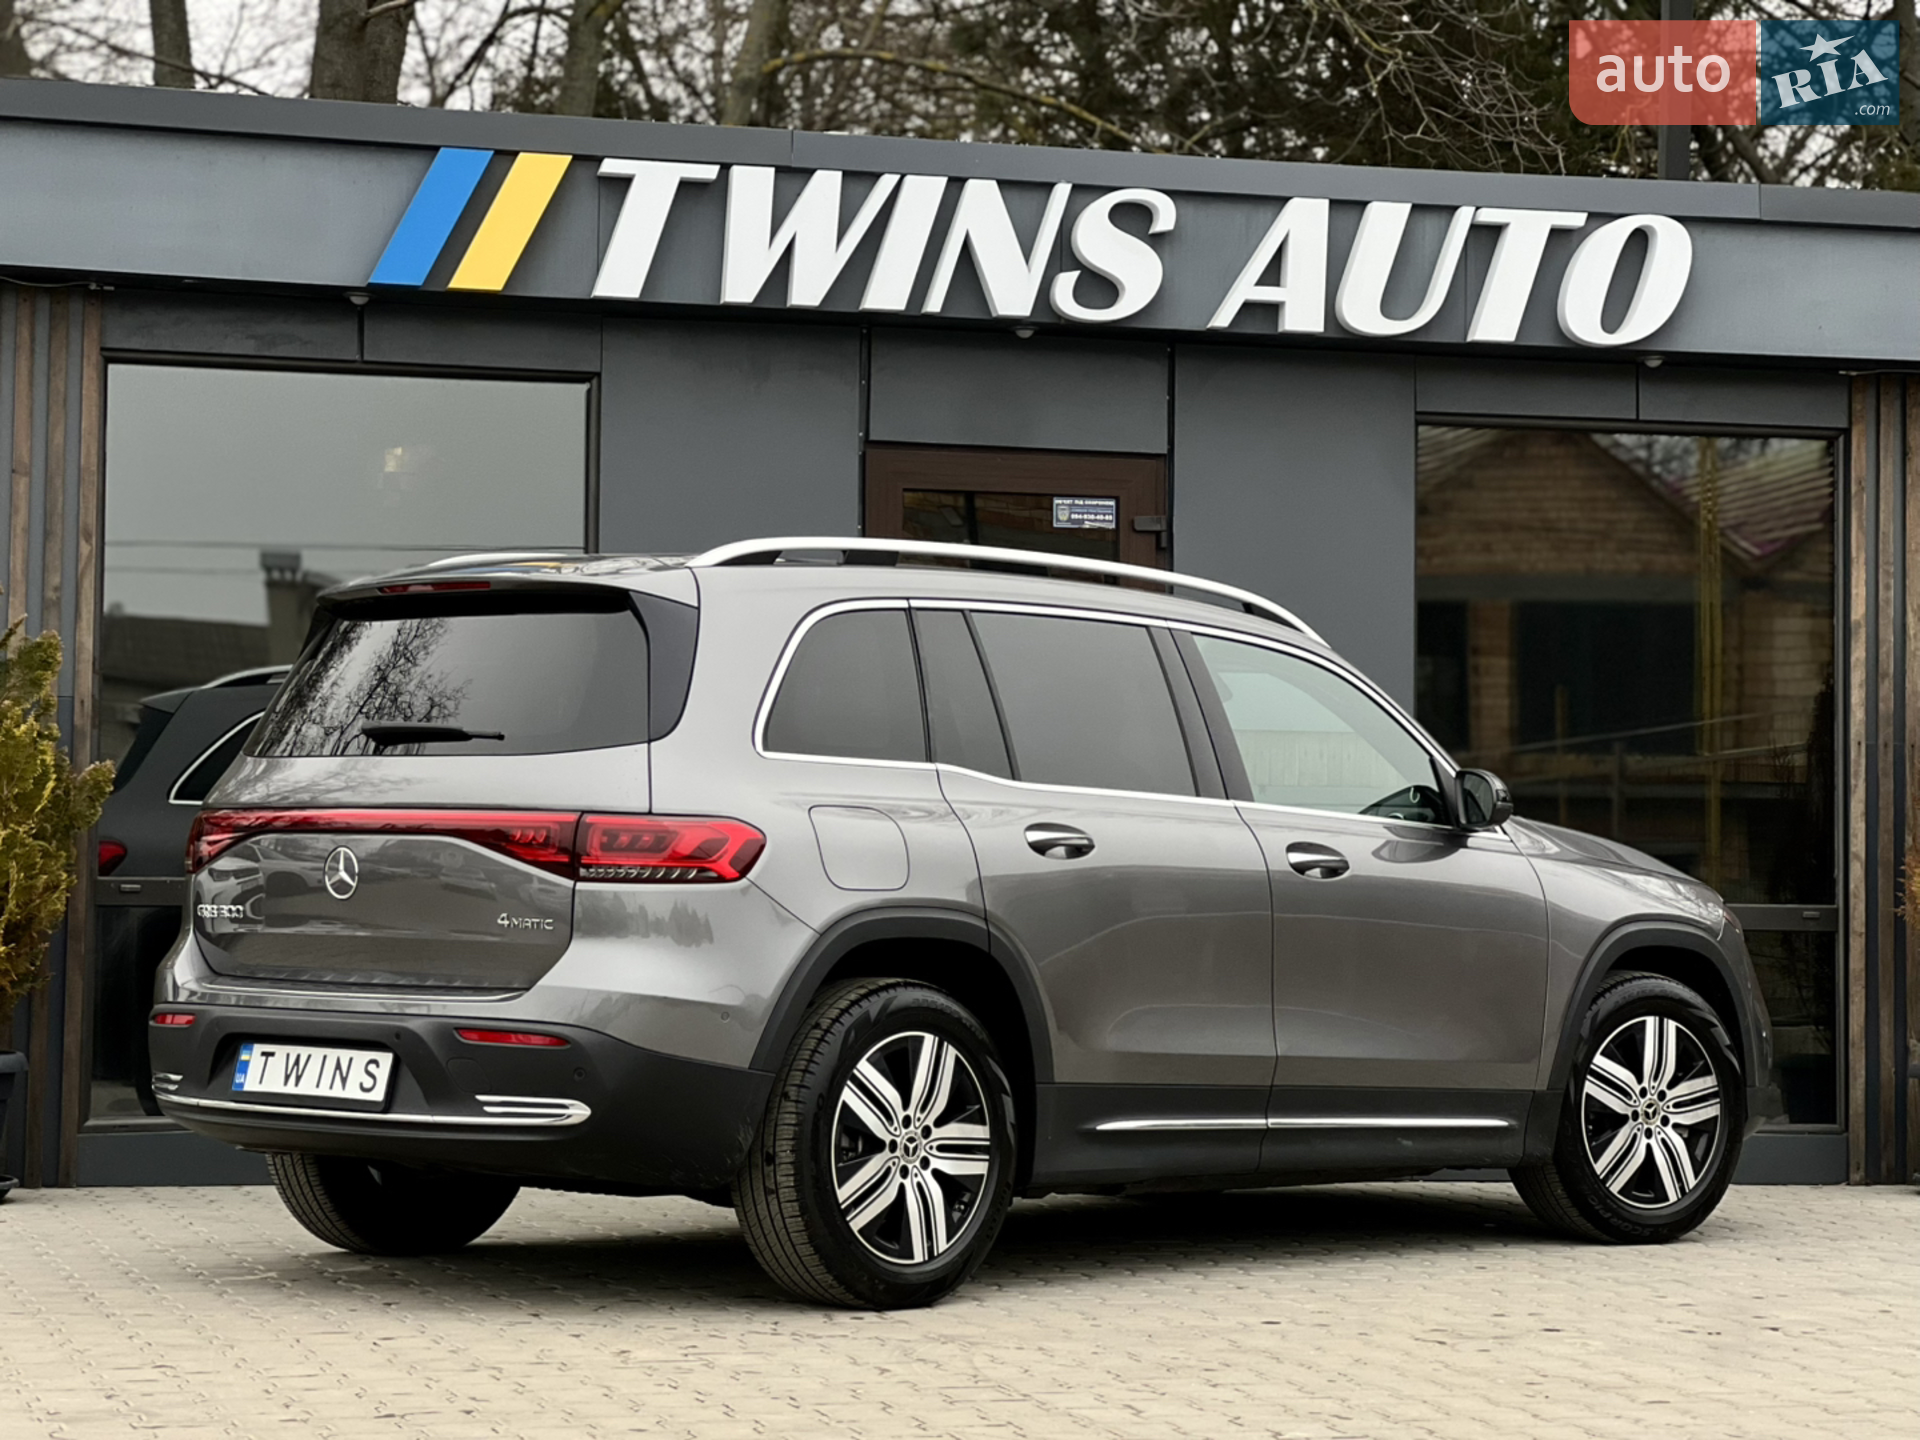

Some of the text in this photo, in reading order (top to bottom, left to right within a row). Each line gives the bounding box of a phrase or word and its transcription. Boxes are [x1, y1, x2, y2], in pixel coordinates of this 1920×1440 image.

[591, 157, 1692, 346] TWINS AUTO
[496, 912, 554, 931] 4MATIC
[235, 1072, 245, 1084] UA
[258, 1050, 381, 1094] TWINS
